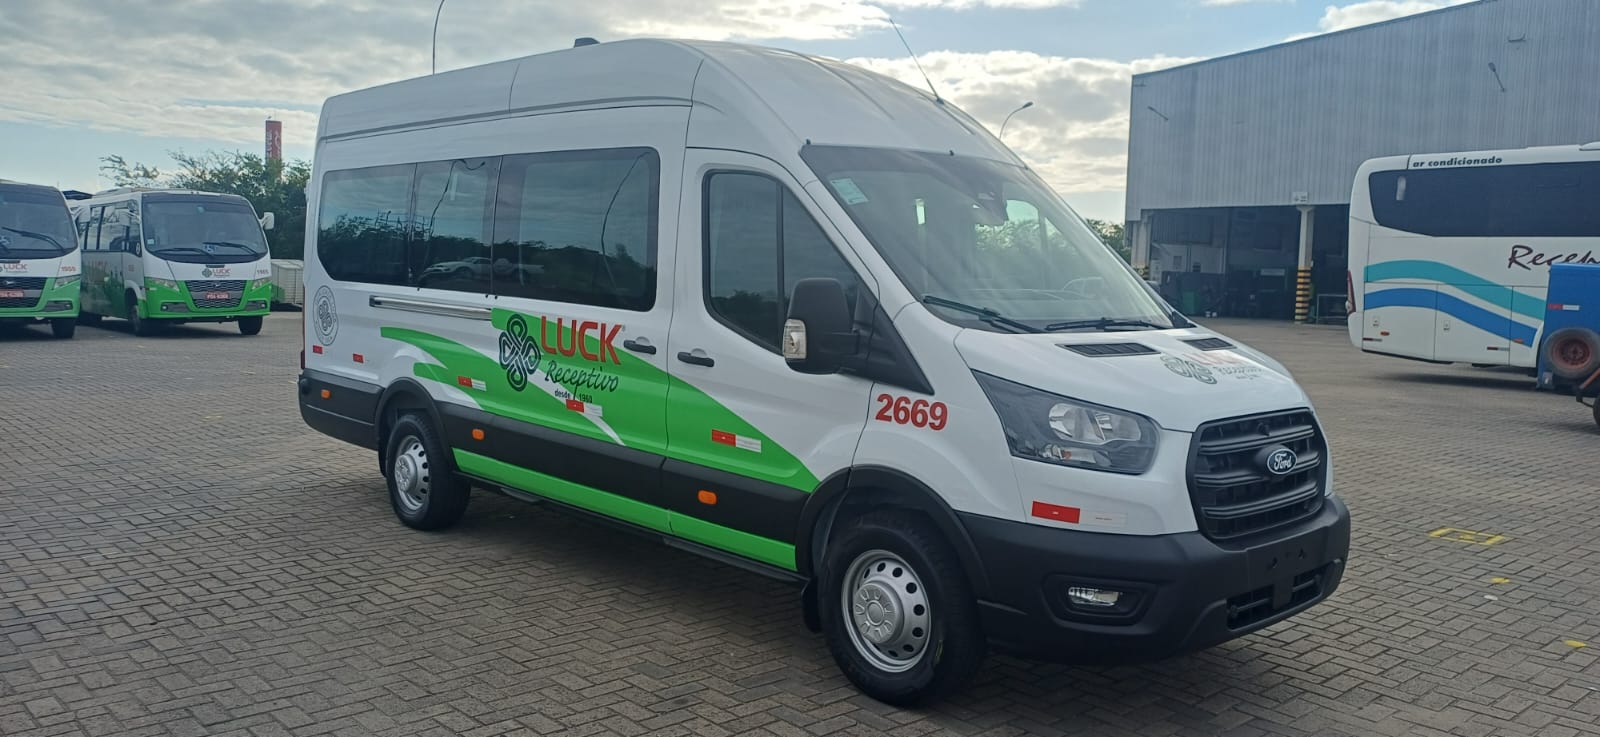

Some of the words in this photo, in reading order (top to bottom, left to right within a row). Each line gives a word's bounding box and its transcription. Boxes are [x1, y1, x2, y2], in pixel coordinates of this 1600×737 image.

[1412, 160, 1425, 168] ar
[1428, 155, 1503, 167] condicionado
[541, 315, 622, 366] LUCK
[544, 360, 619, 401] Receptivo
[554, 388, 571, 399] desde
[875, 393, 948, 431] 2669
[1272, 451, 1293, 471] Ford
